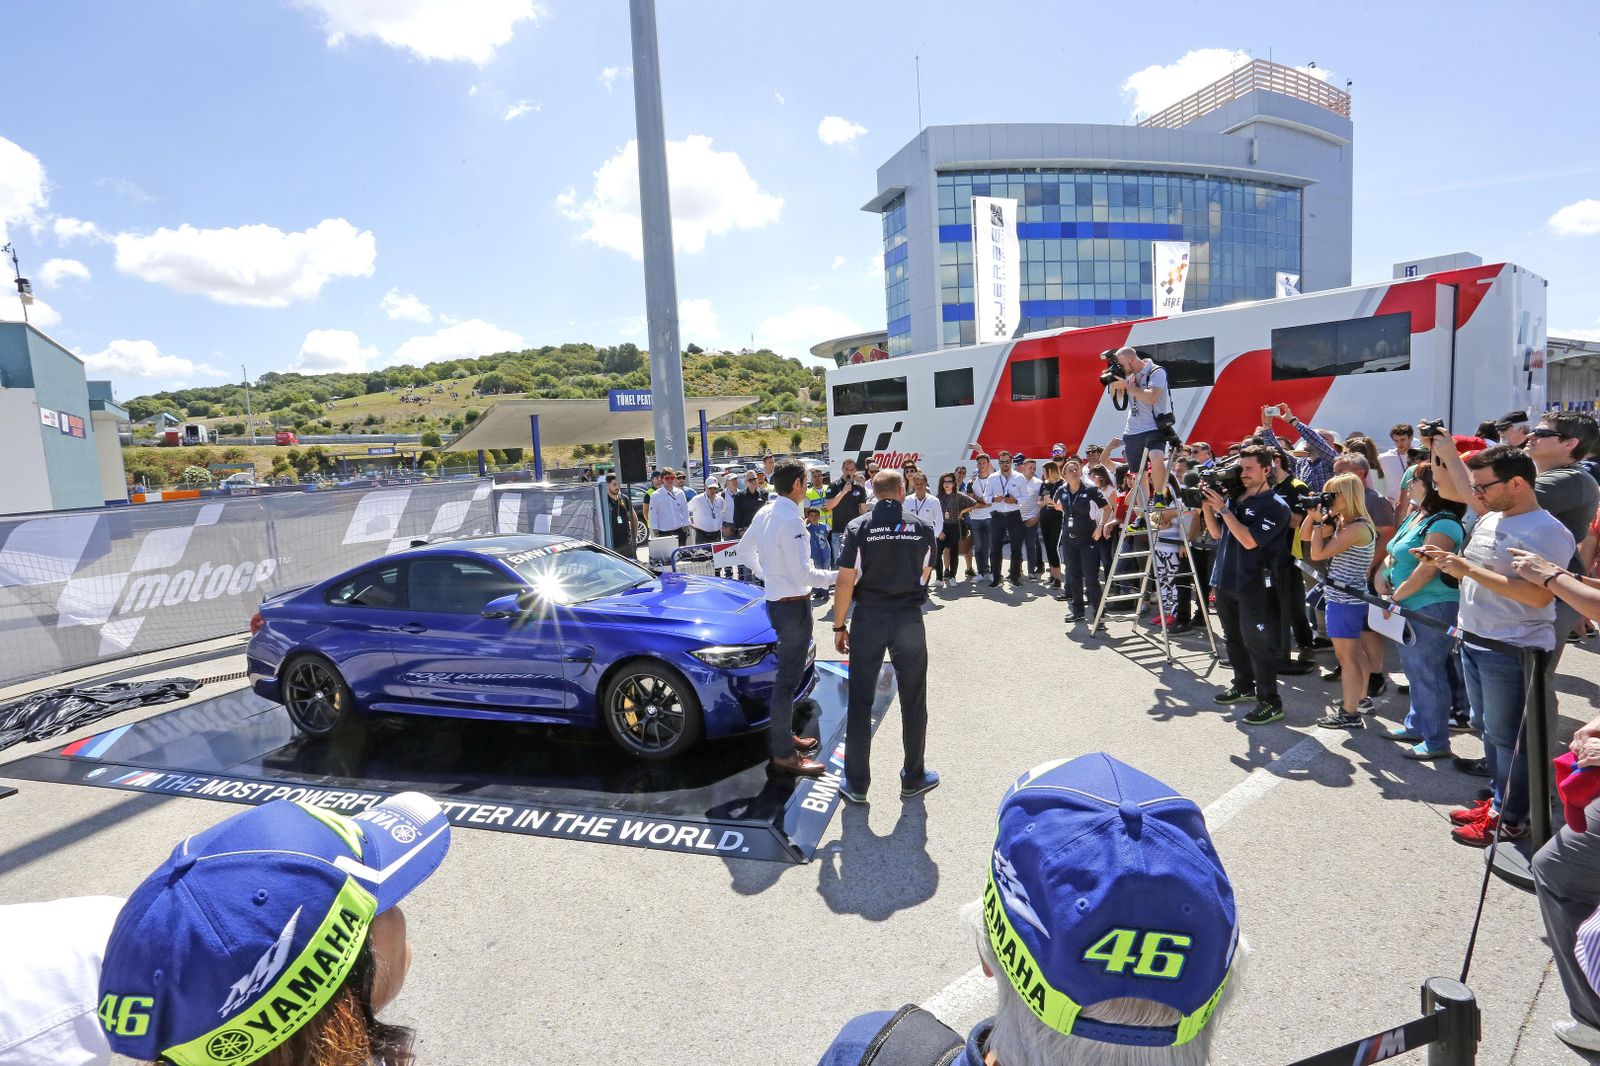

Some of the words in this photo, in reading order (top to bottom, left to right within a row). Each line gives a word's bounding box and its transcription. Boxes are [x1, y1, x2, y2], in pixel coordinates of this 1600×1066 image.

[637, 394, 653, 406] PEAT
[507, 547, 548, 565] BMW
[155, 774, 209, 792] THE
[196, 779, 275, 800] MOST
[511, 808, 551, 830] IN
[551, 812, 618, 838] THE
[618, 819, 750, 853] WORLD.
[244, 906, 360, 1035] YAMAHA
[325, 918, 365, 990] RACING
[984, 881, 1046, 1012] YAMAHA
[1083, 928, 1192, 979] 46
[97, 992, 155, 1036] 46
